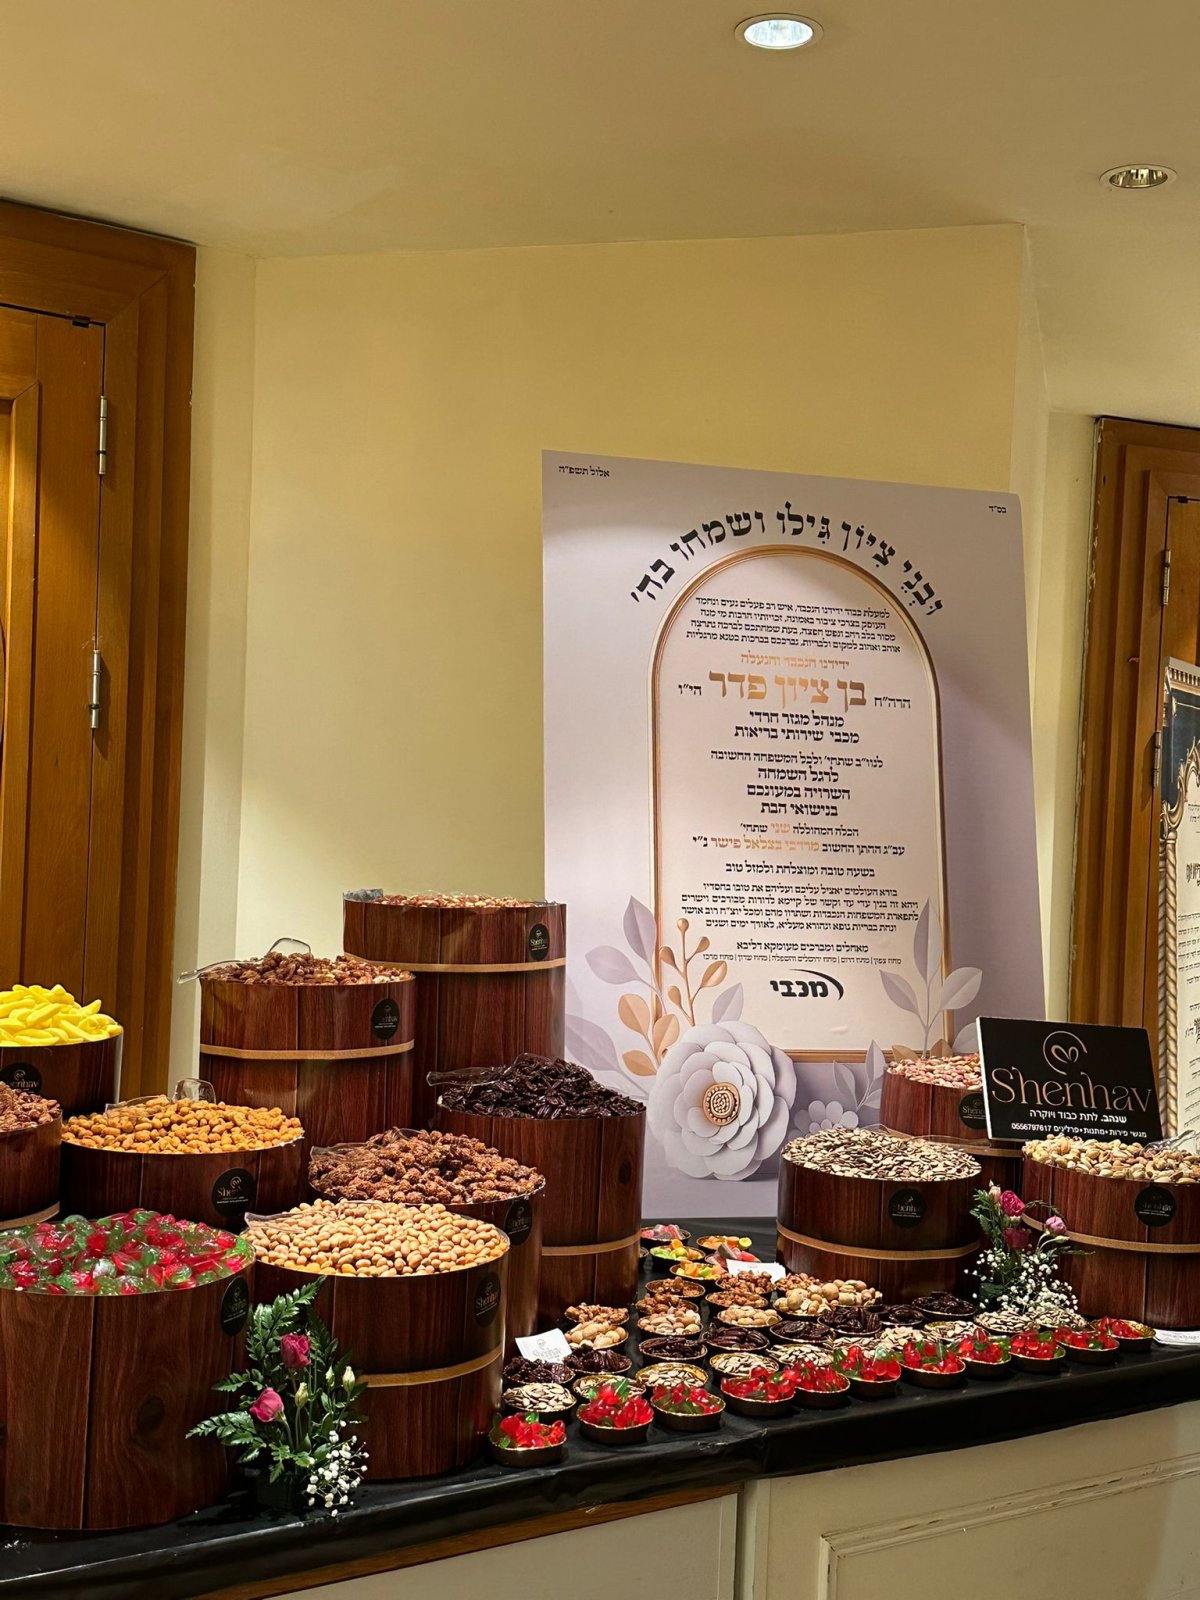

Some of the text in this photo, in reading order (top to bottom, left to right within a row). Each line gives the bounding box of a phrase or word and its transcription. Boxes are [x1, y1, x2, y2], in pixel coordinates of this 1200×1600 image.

[591, 466, 610, 477] אלול
[670, 510, 765, 560] ושמחו
[740, 599, 765, 610] פעלים
[766, 602, 776, 610] רב
[777, 603, 793, 612] איש
[795, 604, 820, 614] הנכבד,
[718, 610, 727, 618] מי
[729, 612, 752, 620] הרבות
[844, 608, 862, 616] כבוד
[863, 608, 890, 618] למעלת
[717, 621, 744, 631] לברכה
[815, 617, 836, 626] ציבור
[837, 619, 860, 628] בצרכי
[861, 621, 886, 629] העוסק
[744, 623, 780, 633] שמחתכם
[781, 626, 798, 635] בעת
[824, 628, 844, 638] ונפש
[686, 630, 718, 640] מרגליות
[844, 631, 860, 639] רחב
[861, 630, 876, 640] בלב
[876, 633, 896, 641] מסור
[832, 640, 858, 650] למקום
[859, 643, 880, 651] ואהוב
[882, 644, 900, 653] אוהב
[740, 651, 782, 666] והנעלה
[818, 659, 850, 670] ידידנו
[708, 670, 768, 700] פדר
[774, 676, 829, 708] ציון
[836, 679, 867, 712] בן
[749, 711, 844, 728] מנהל מגזר חרדי
[734, 726, 860, 744] מכבי שירותי בריאות
[711, 750, 751, 761] החשובה
[753, 753, 798, 764] המשפחה
[799, 751, 822, 766] ולכל
[758, 767, 839, 783] לרגל השמחה
[747, 784, 850, 800] השרויה במעונכם
[760, 802, 838, 816] בנישואי הבת
[771, 823, 790, 834] שני
[793, 822, 833, 836] המהוללה
[834, 824, 859, 837] הכלה
[710, 837, 742, 849] פישר
[743, 836, 783, 850] בצלאל
[784, 840, 820, 852] מרדכי
[822, 843, 854, 853] החשוב
[726, 860, 875, 878] בשעה טובה ומוצלחת ולמזל טוב
[703, 883, 731, 891] בחסדיו
[732, 884, 750, 892] טובו
[751, 884, 764, 892] את
[765, 884, 793, 896] ועליהם
[795, 882, 820, 894] עליכם
[821, 883, 843, 895] יאציל
[844, 885, 878, 897] העולמים
[712, 895, 746, 906] מבורכים
[748, 895, 776, 906] לדורות
[778, 897, 802, 907] קיימא
[803, 896, 818, 906] של
[819, 898, 841, 908] וקשר
[843, 900, 854, 908] עד
[857, 900, 871, 908] עדי
[872, 900, 888, 909] בנין
[681, 906, 704, 914] אושר
[705, 907, 718, 915] רוב
[742, 907, 764, 916] ומכל
[764, 909, 783, 918] מהם
[812, 908, 846, 920] הנכבדות
[846, 909, 886, 920] המשפחות
[886, 910, 920, 922] לתפארת
[706, 919, 729, 927] ושנים
[730, 920, 749, 928] ימים
[750, 920, 775, 930] לאורך
[736, 940, 868, 954] מאחלים ומברכים מעומקא דליבא
[770, 980, 829, 998] מכבי
[991, 1066, 1152, 1112] Shenhav
[1057, 1111, 1077, 1120] כבוד
[1079, 1113, 1098, 1121] לתת
[1101, 1115, 1127, 1123] שנהב.
